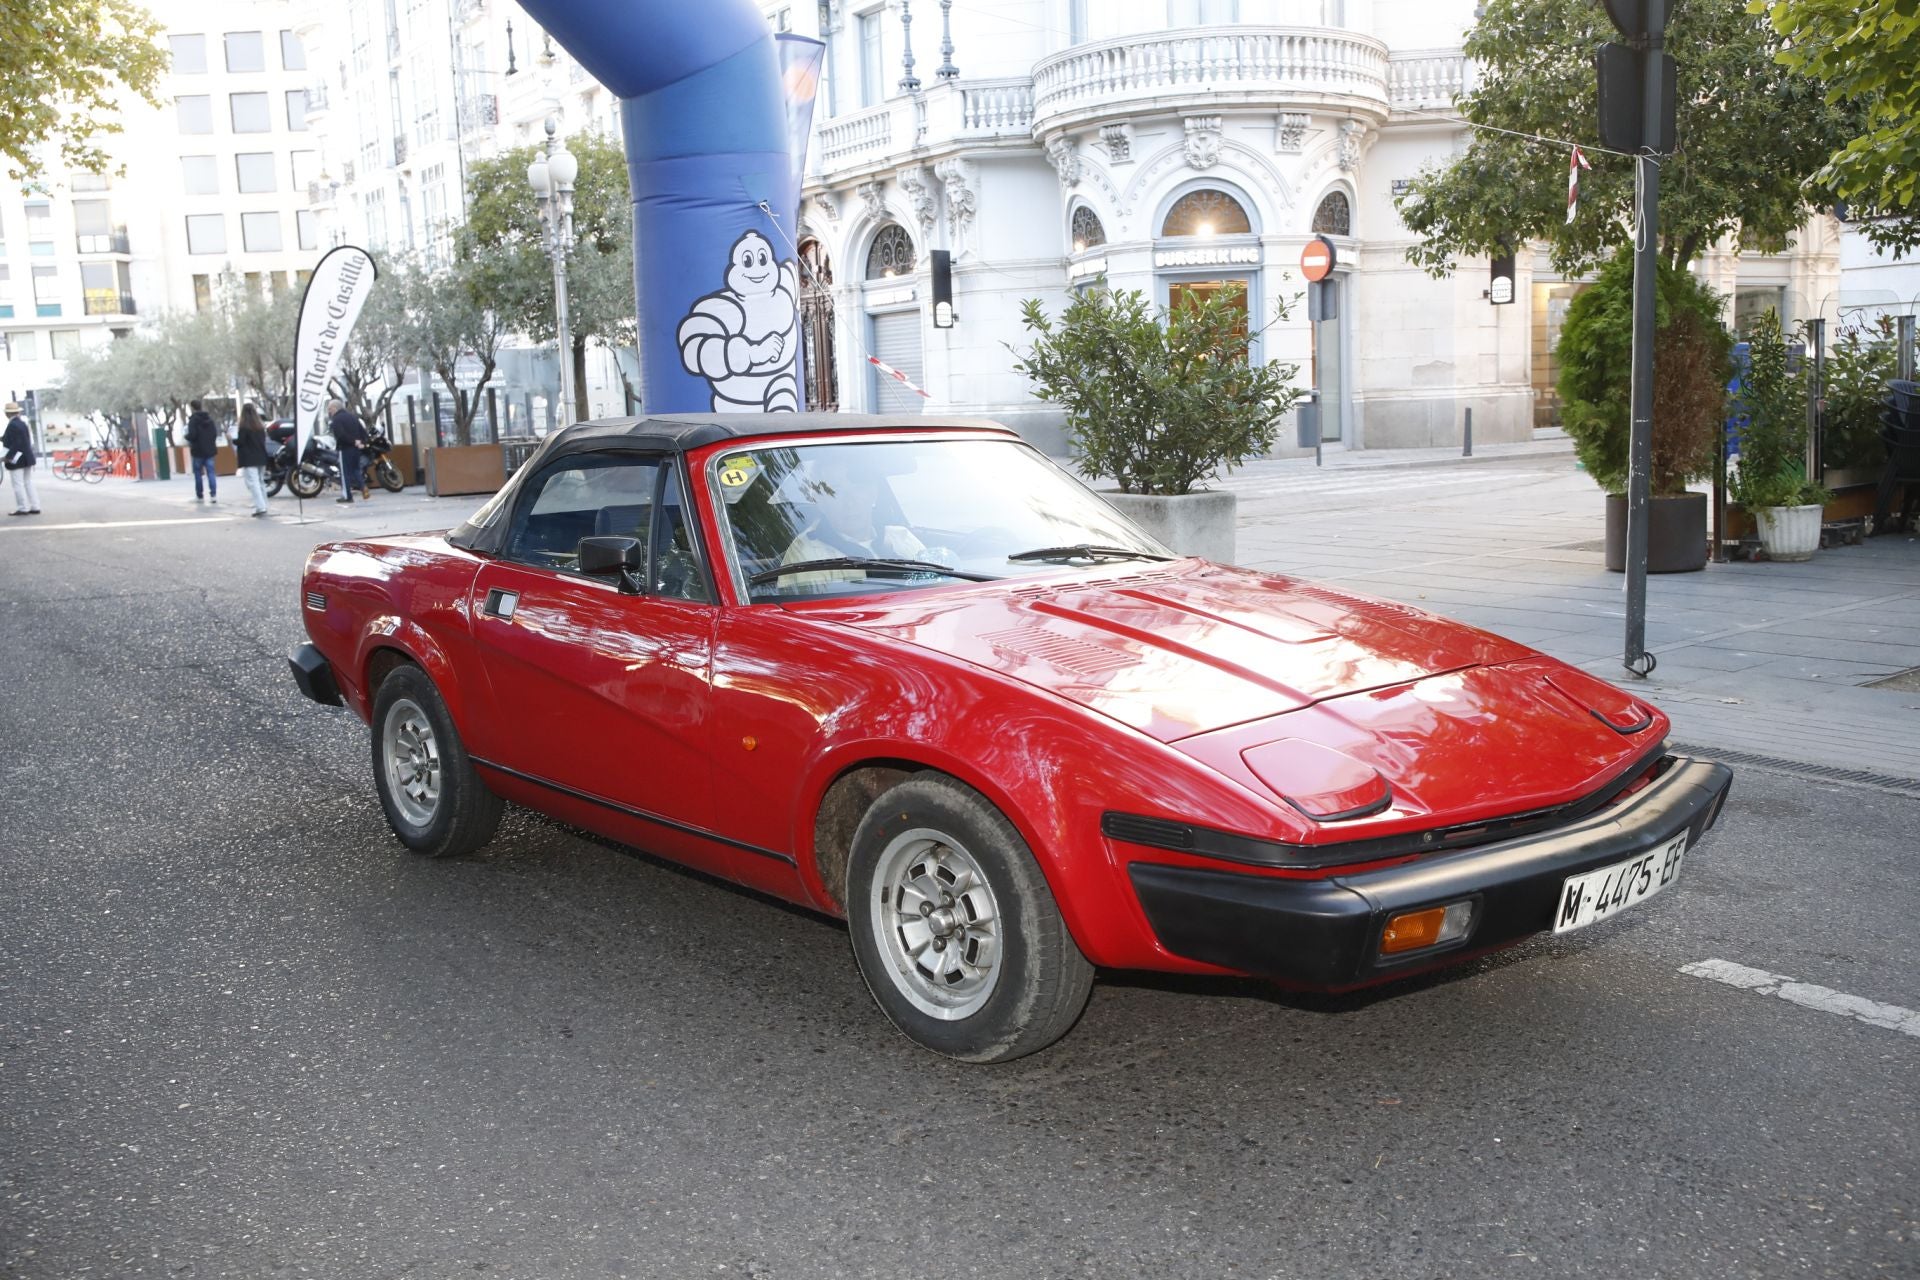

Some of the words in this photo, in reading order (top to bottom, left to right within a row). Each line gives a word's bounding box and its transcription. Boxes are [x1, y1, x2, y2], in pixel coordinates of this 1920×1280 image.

[1154, 249, 1217, 267] BURGER
[1217, 248, 1259, 263] KING
[327, 255, 367, 320] Castilla
[318, 322, 341, 341] de
[305, 341, 334, 390] Norte
[300, 386, 320, 413] El
[725, 471, 744, 485] H
